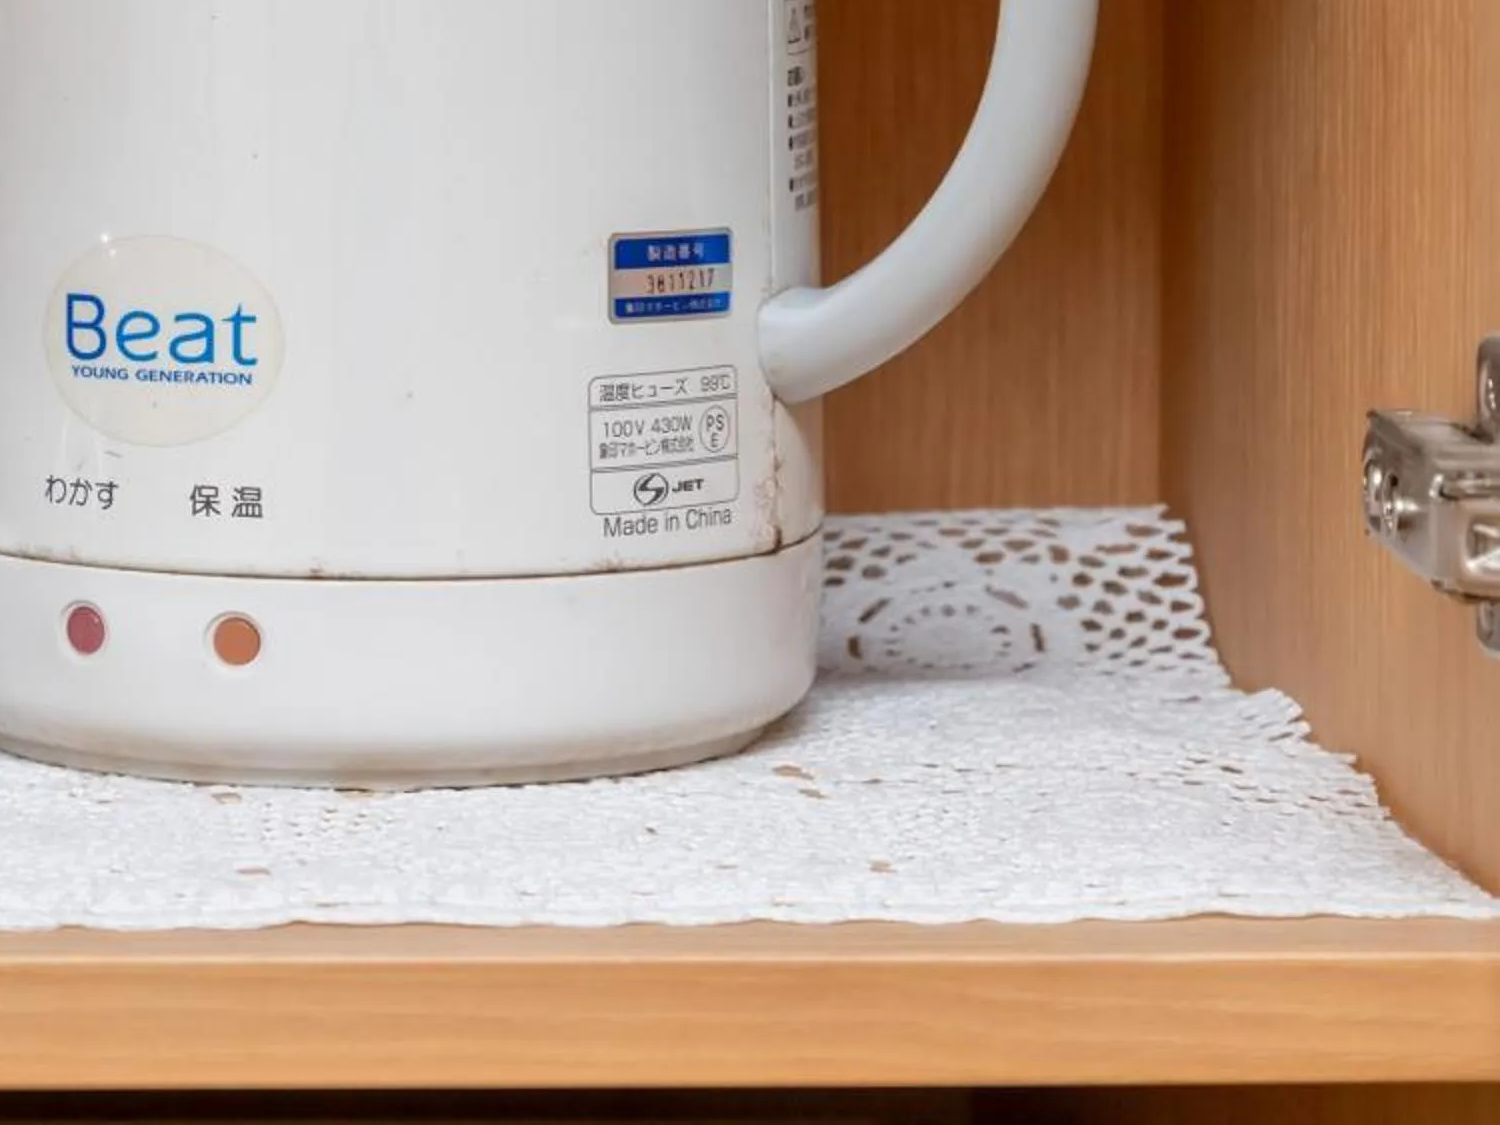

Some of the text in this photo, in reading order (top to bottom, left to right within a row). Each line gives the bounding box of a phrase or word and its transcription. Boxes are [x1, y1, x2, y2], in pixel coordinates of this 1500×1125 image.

[65, 292, 259, 367] Beat
[71, 365, 254, 386] YOUNG GENERATION
[599, 377, 690, 402] 温度ヒューズ
[603, 412, 693, 438] 100V 430W
[705, 414, 726, 433] PS
[711, 432, 721, 449] E
[45, 474, 265, 519] わかす 保温
[671, 478, 704, 493] JET
[603, 505, 732, 538] Made in China
